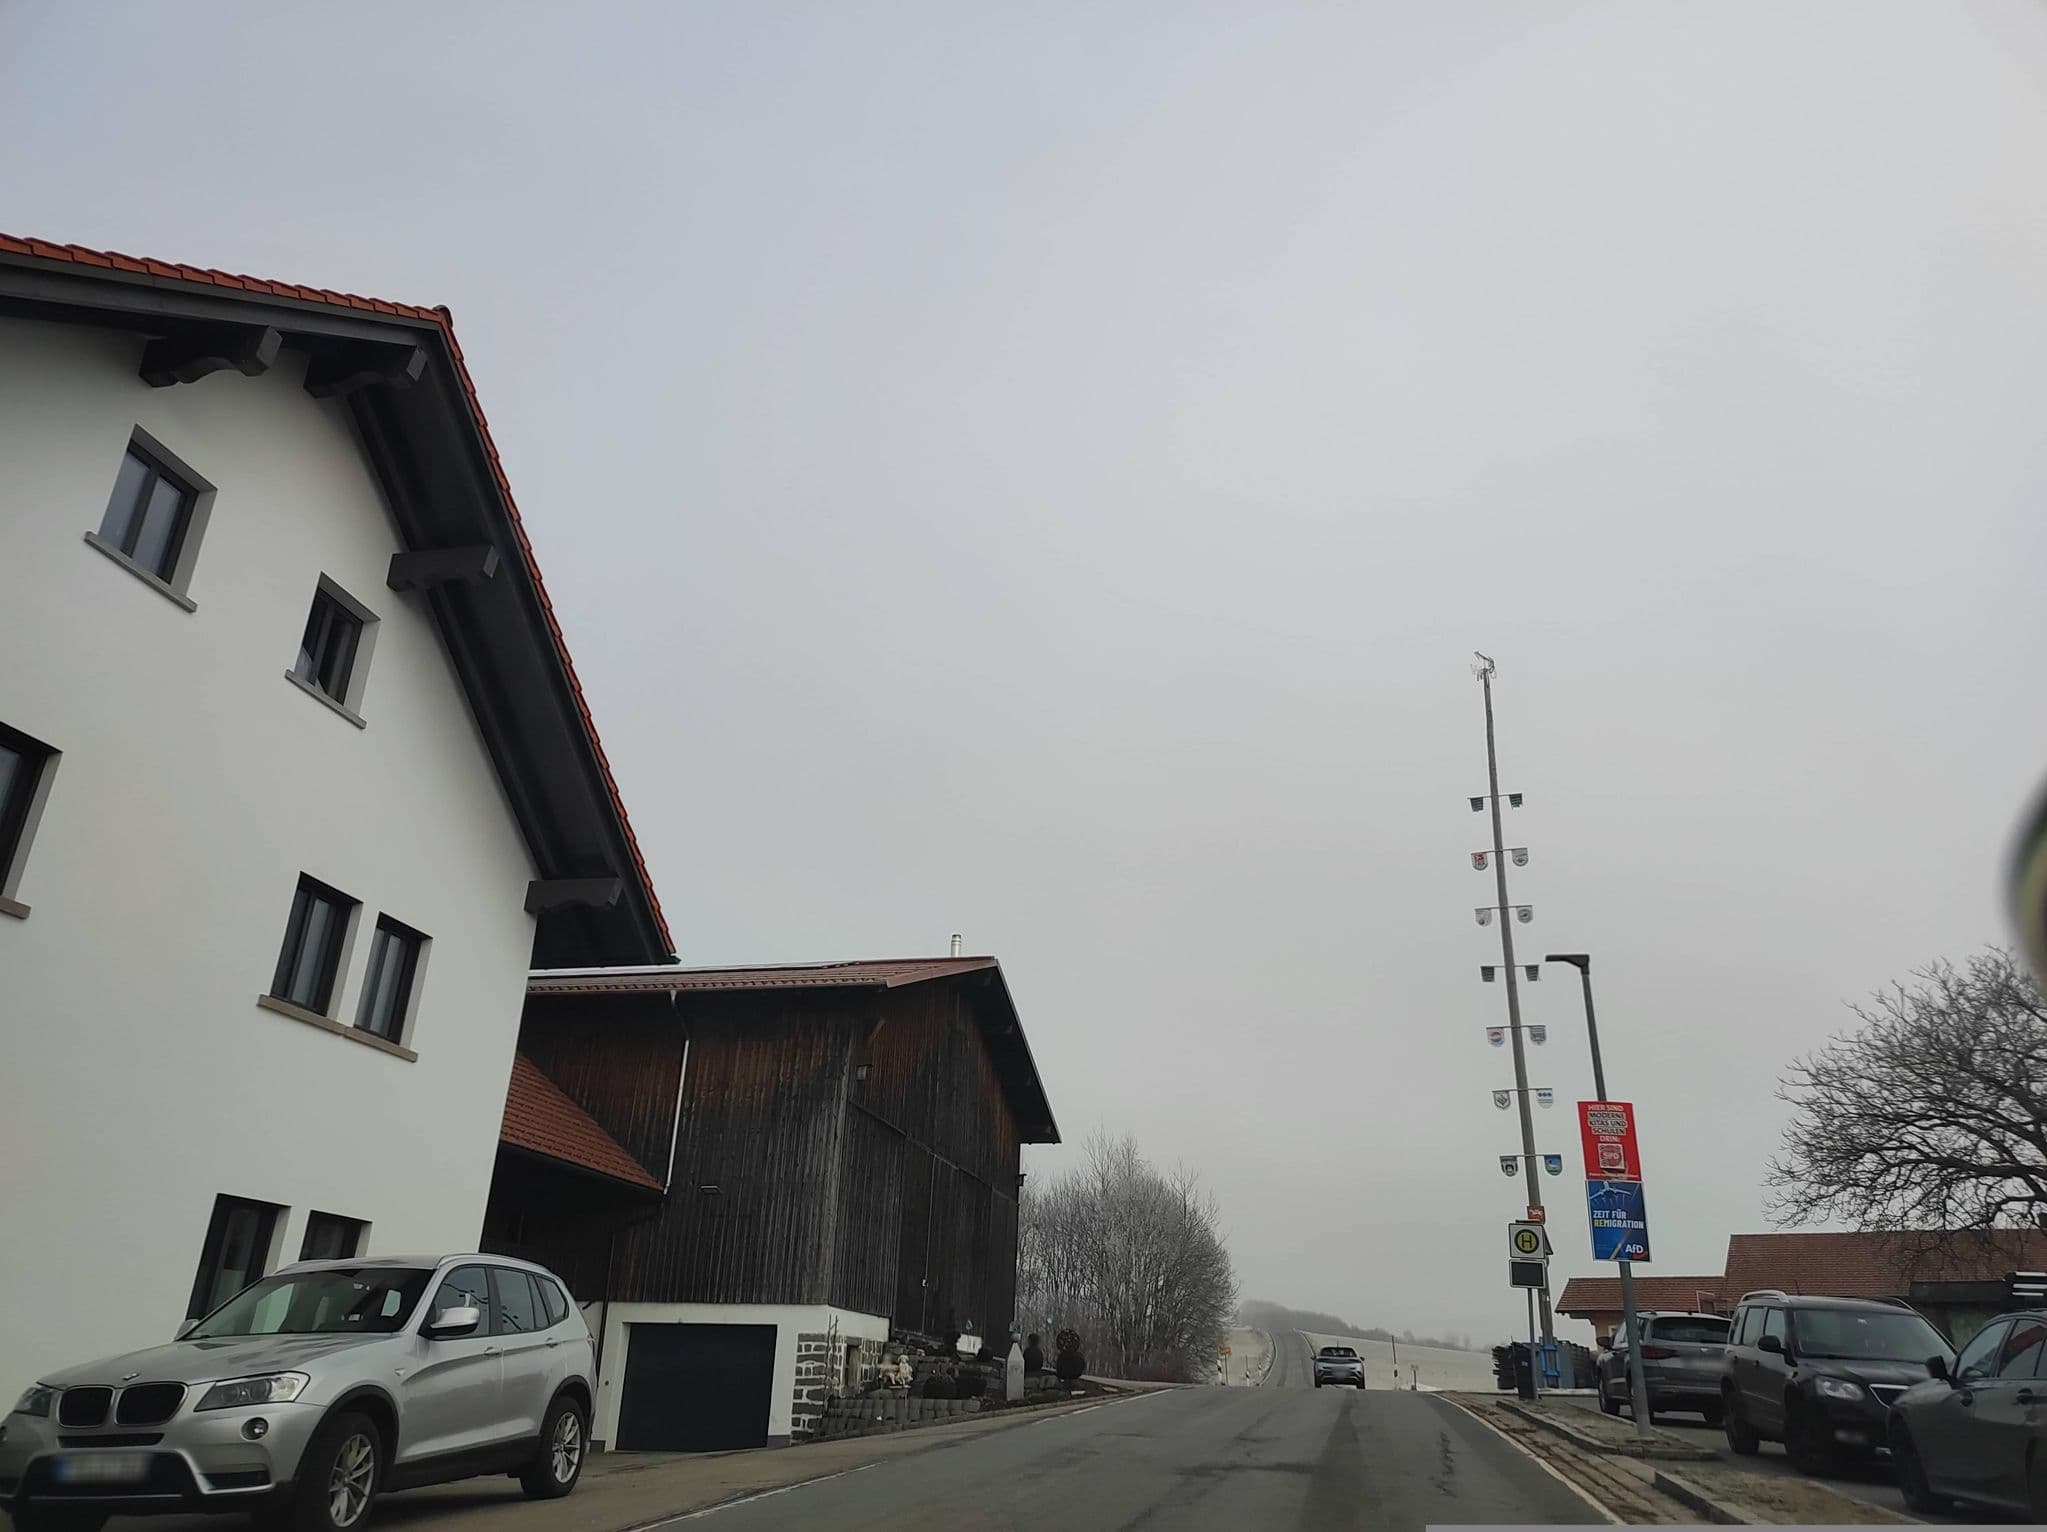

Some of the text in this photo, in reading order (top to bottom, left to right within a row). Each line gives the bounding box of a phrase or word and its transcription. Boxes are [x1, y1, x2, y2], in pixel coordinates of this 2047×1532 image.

[1593, 1208, 1627, 1219] ZEIT FÜR
[1593, 1219, 1645, 1229] REMIGRATION
[1521, 1234, 1532, 1249] H
[1625, 1243, 1644, 1254] AfD
